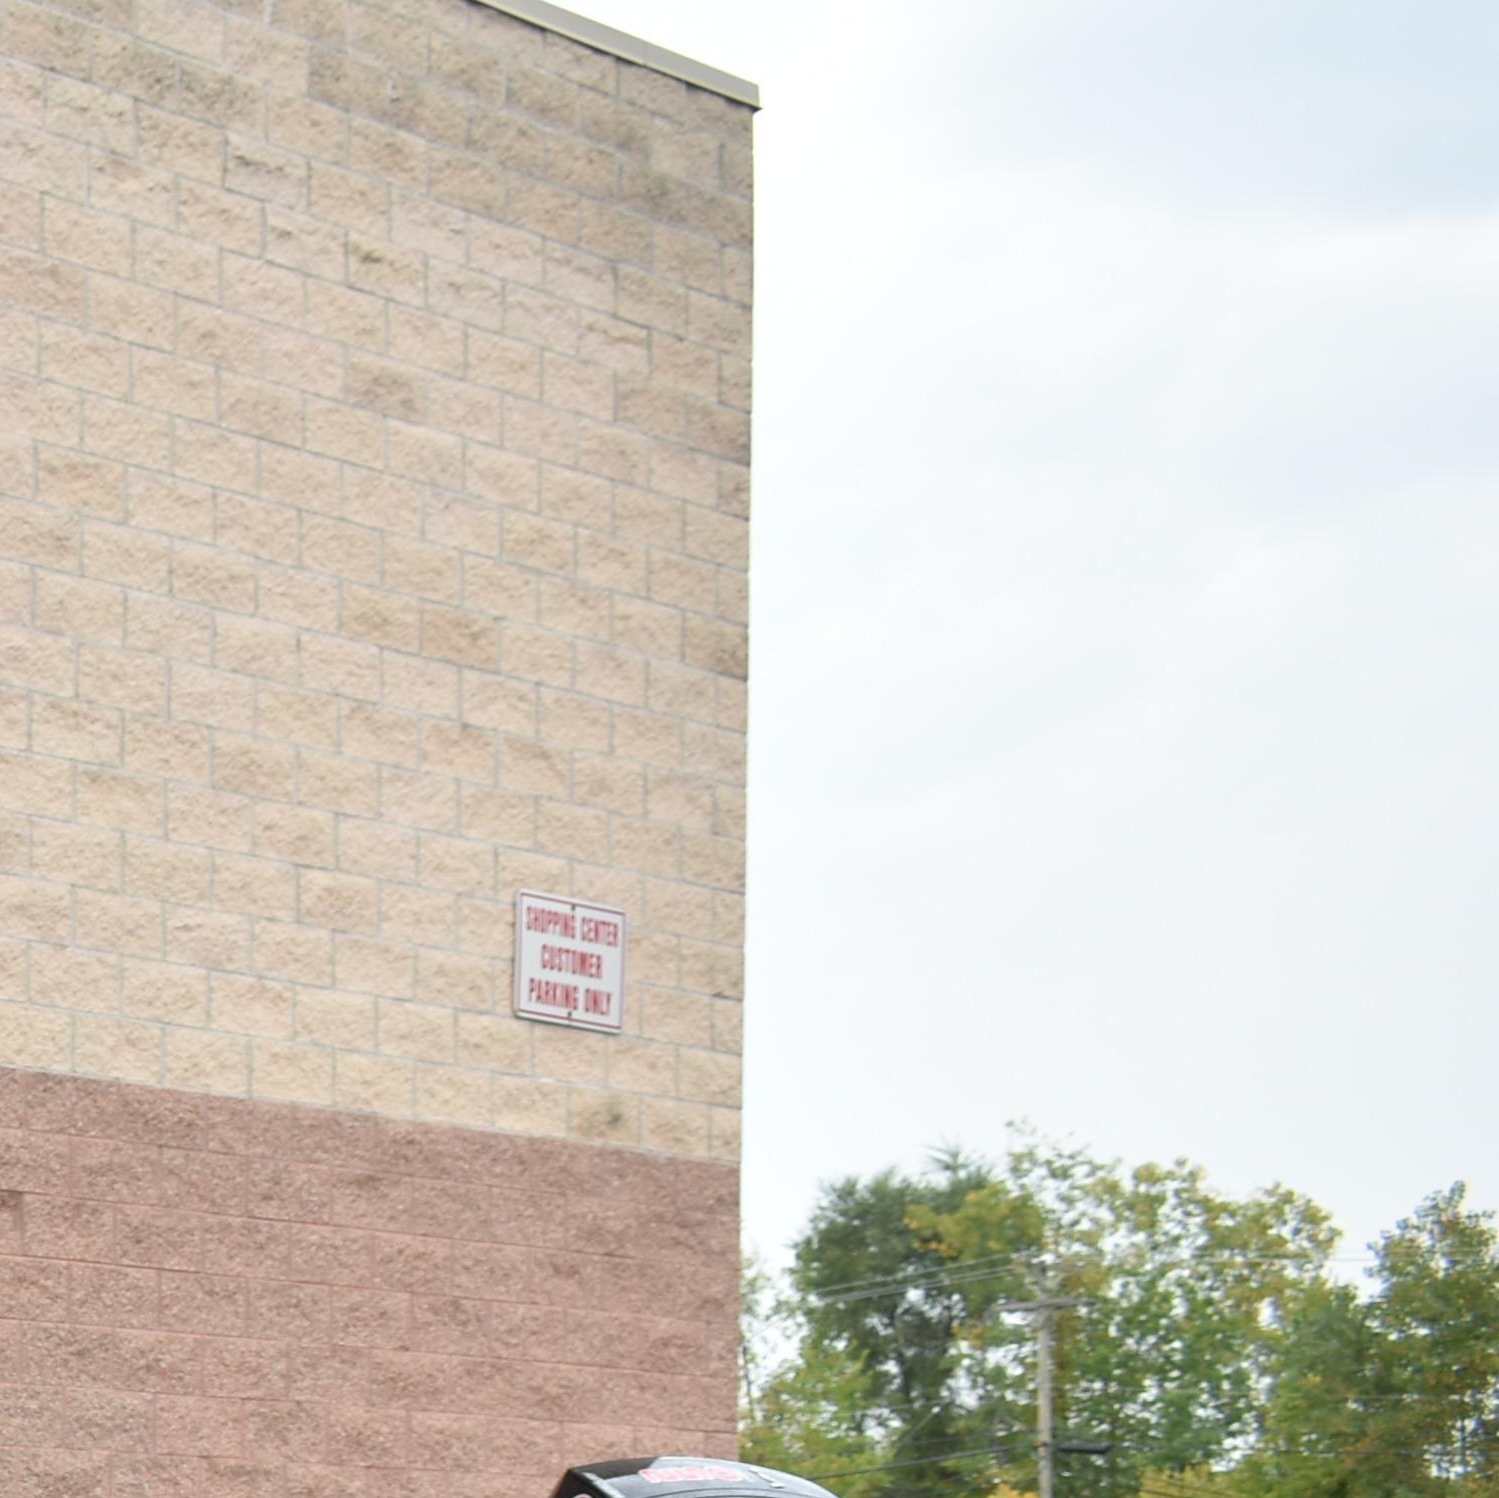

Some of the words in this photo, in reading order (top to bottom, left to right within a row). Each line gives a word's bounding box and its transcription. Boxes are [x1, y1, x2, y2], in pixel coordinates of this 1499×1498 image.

[581, 917, 619, 947] CENTER
[541, 944, 603, 979] CUSTOMER
[529, 977, 578, 1011] PARKING
[585, 988, 612, 1017] ONLY
